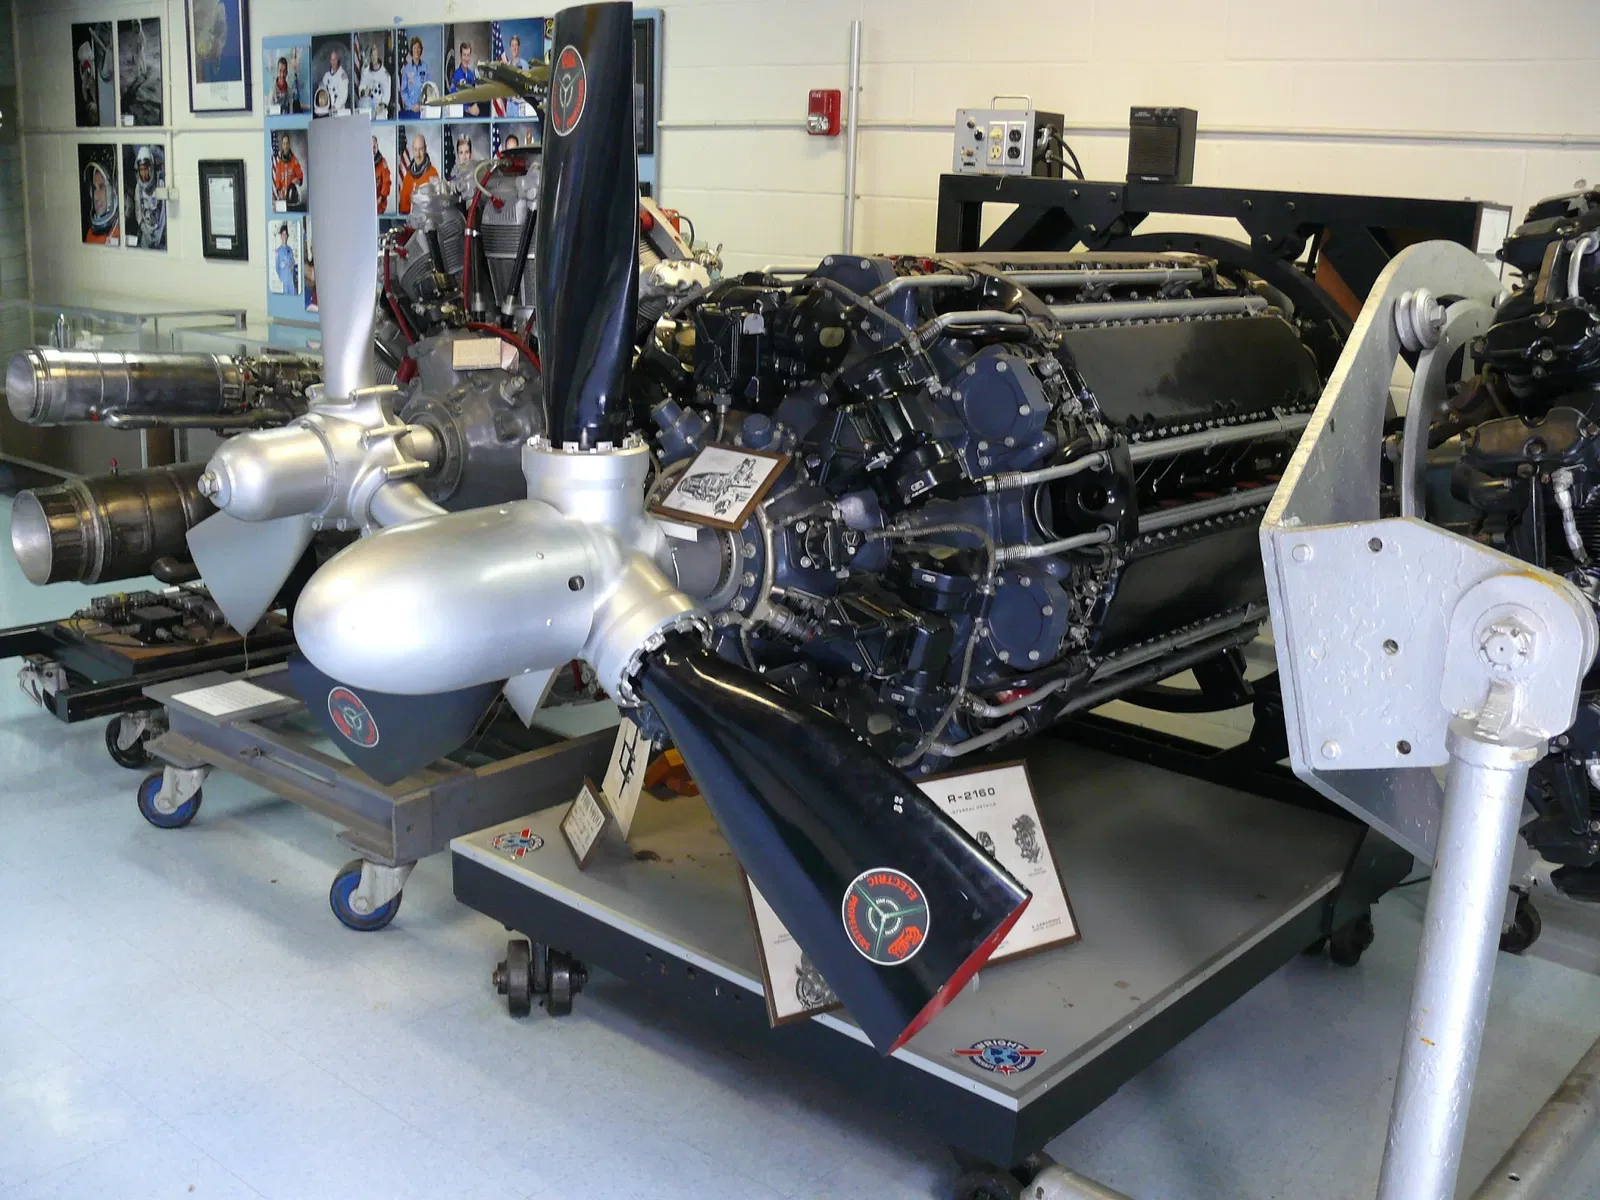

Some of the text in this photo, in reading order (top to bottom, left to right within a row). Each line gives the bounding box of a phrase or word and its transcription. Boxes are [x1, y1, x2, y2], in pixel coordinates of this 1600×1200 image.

[947, 787, 995, 803] R-2160
[866, 873, 918, 901] ELECTRIC
[974, 1039, 1025, 1050] WRIGHT
